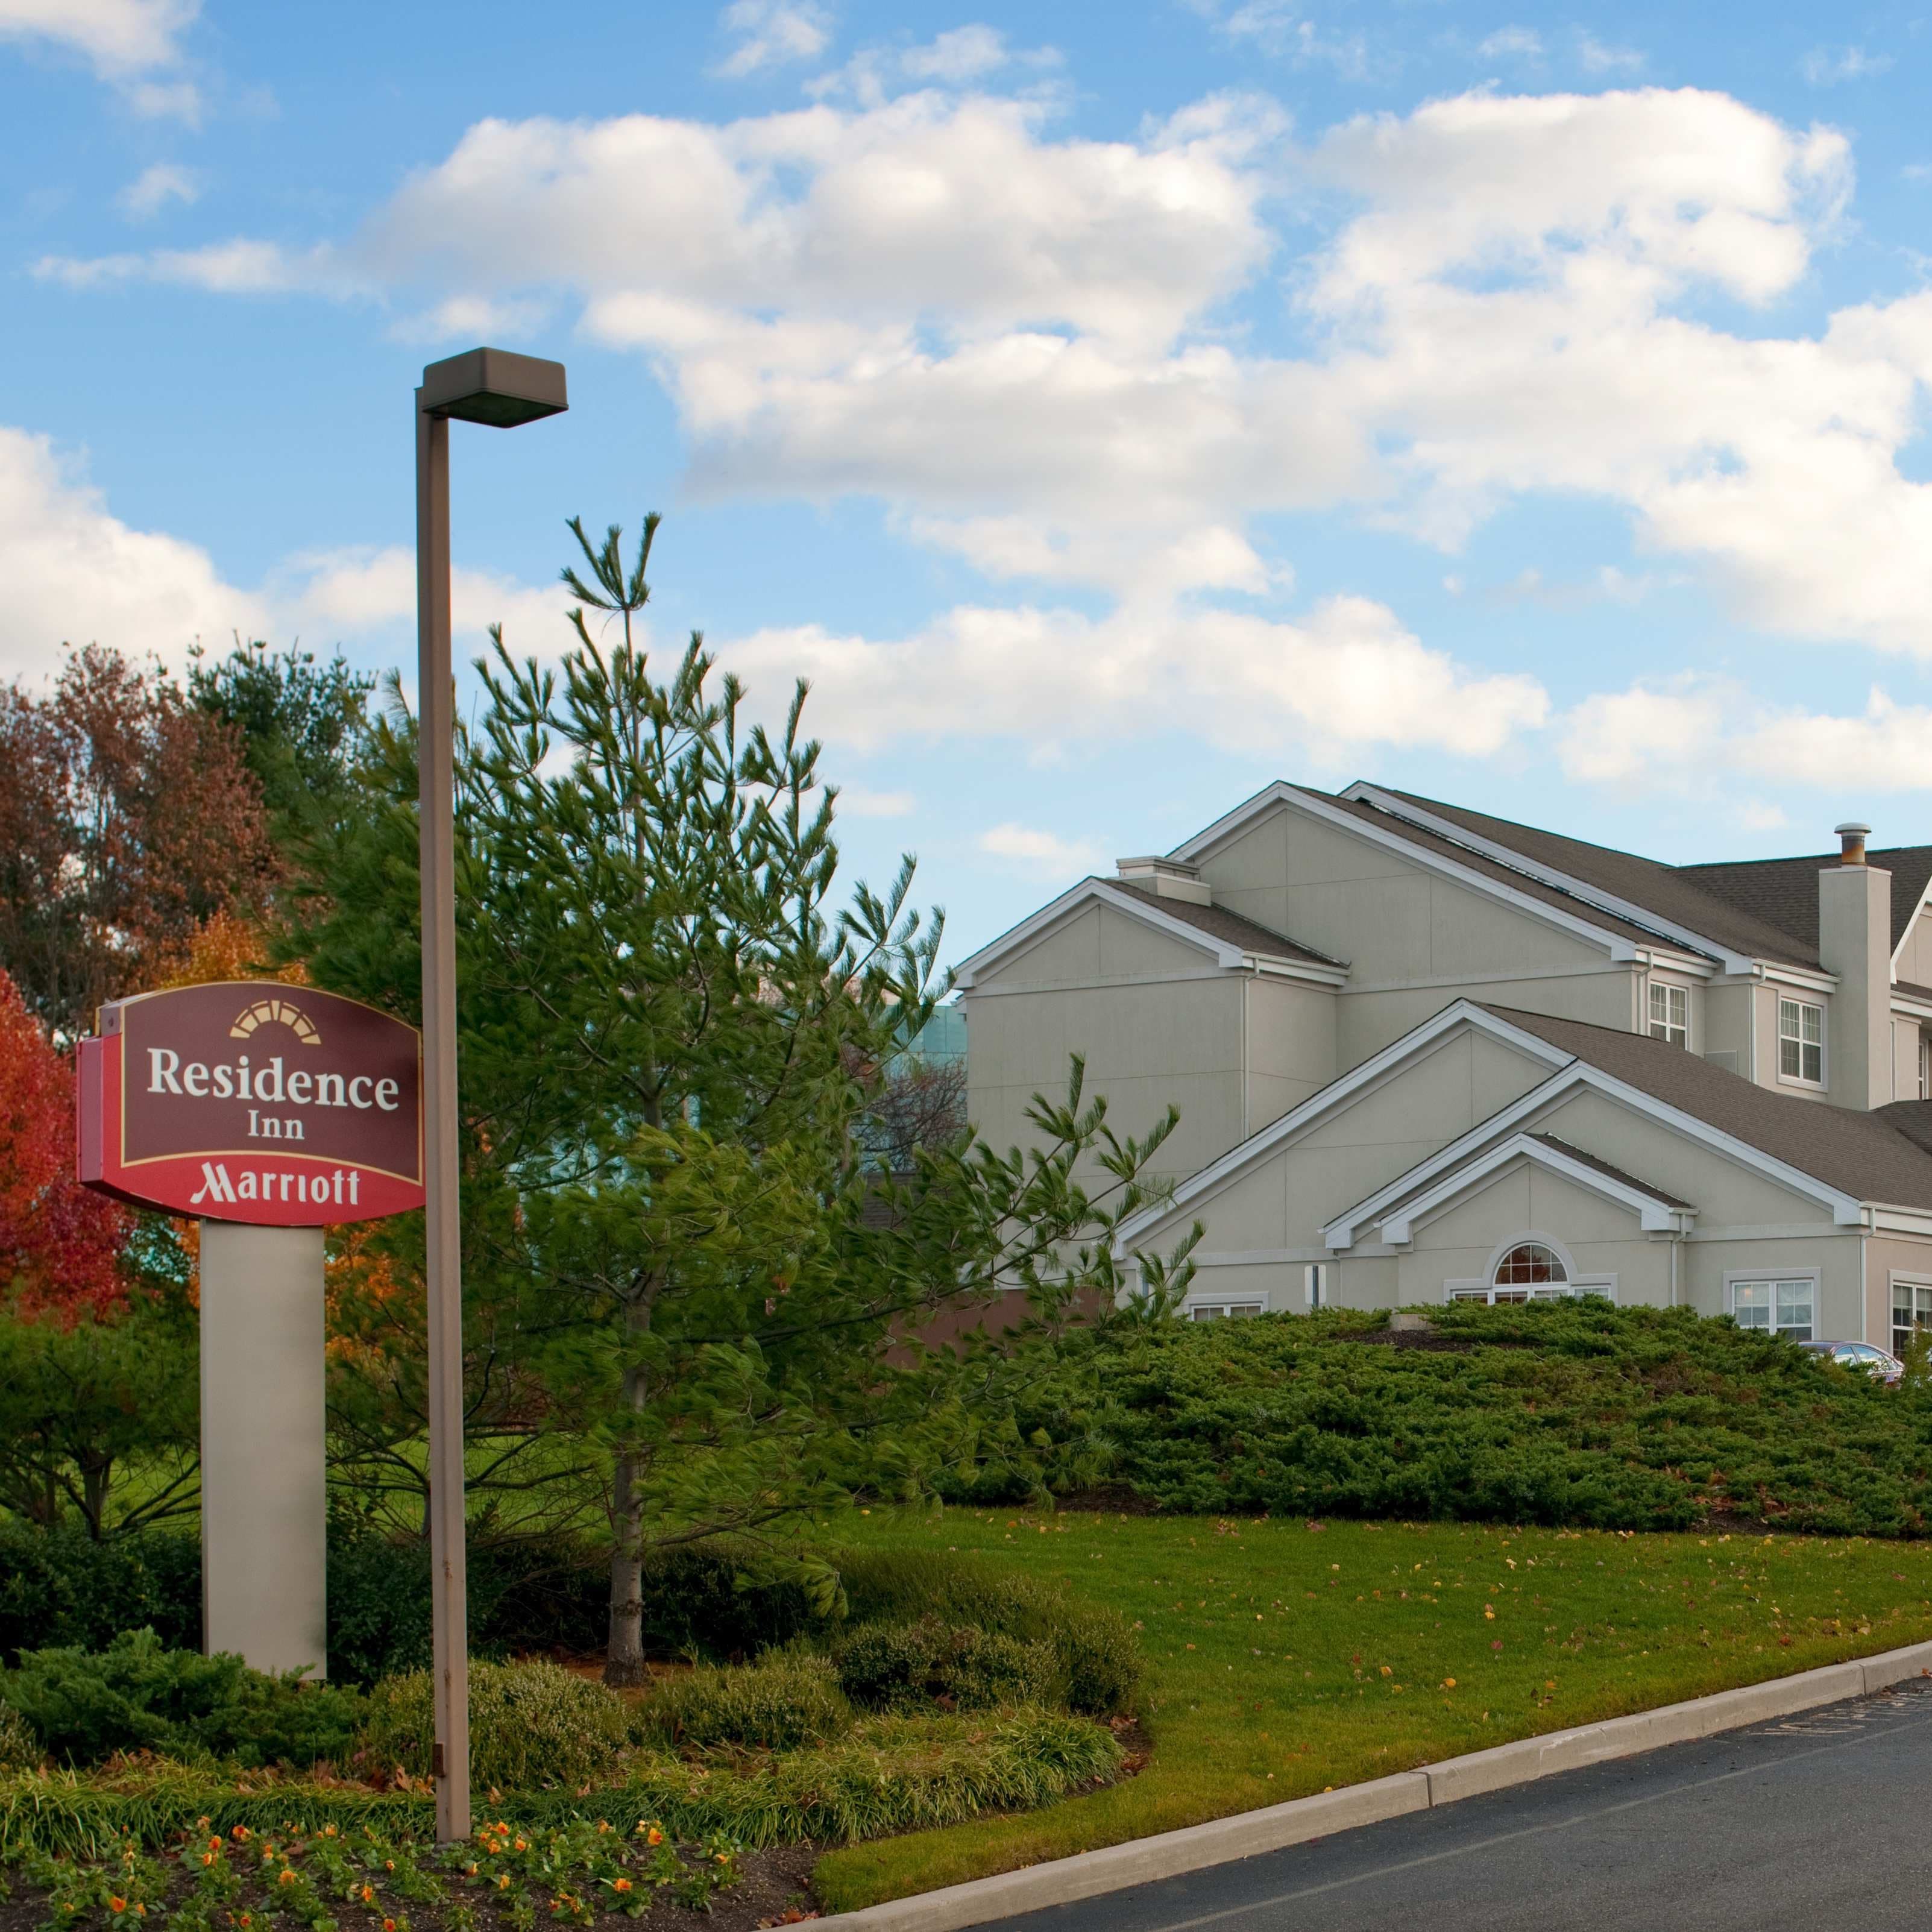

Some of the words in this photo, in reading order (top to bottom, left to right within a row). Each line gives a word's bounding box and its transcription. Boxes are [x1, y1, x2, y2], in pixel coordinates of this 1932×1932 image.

[146, 1047, 399, 1111] Residence
[247, 1109, 305, 1140] Inn
[189, 1161, 360, 1206] Marriott
